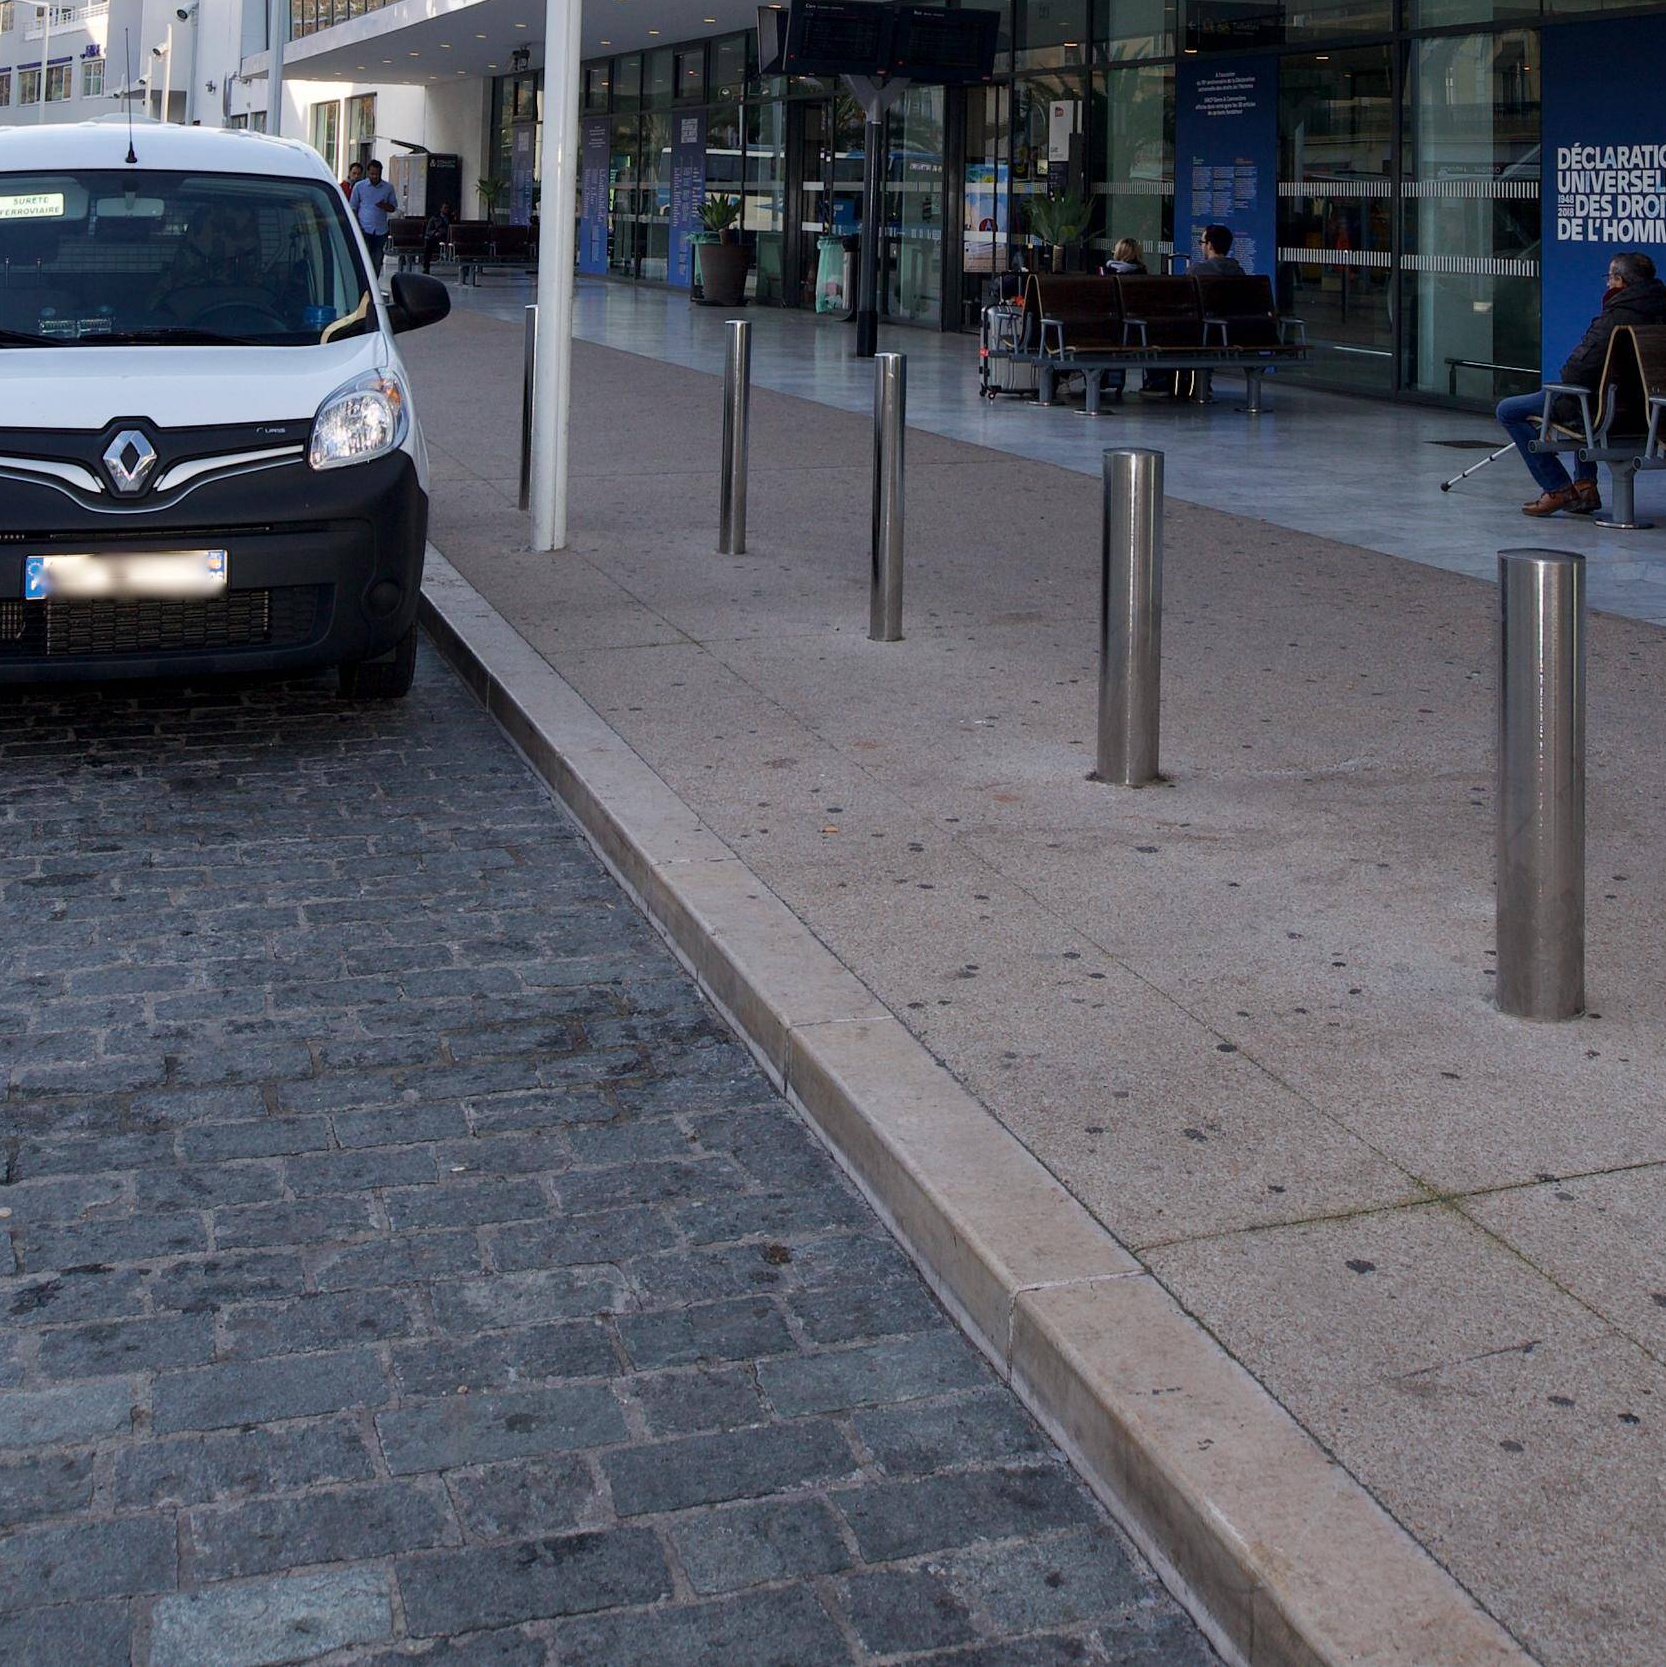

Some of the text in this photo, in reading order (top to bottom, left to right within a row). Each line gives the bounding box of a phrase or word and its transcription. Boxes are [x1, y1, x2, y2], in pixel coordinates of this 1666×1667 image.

[1557, 195, 1574, 203] 1948
[0, 206, 60, 216] FERROVIAIRE
[1575, 194, 1612, 218] DES
[1557, 207, 1574, 217] 2018
[1557, 218, 1583, 241] DE
